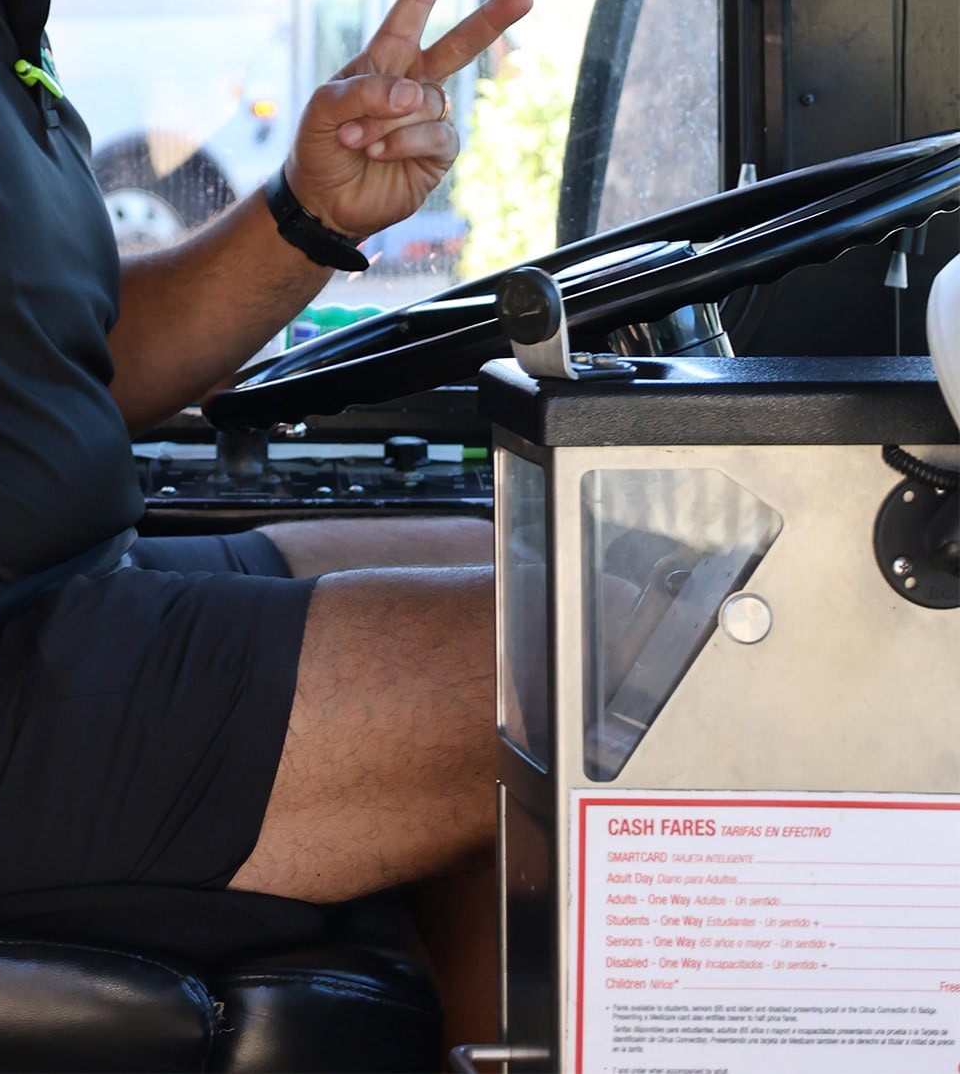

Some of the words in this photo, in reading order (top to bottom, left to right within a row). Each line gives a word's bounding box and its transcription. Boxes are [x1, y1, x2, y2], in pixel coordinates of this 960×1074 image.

[608, 819, 654, 836] CASH
[661, 819, 716, 836] FARES
[720, 826, 762, 837] TARIFAS
[765, 826, 779, 837] EN
[782, 827, 831, 838] EFECTIVO
[607, 852, 668, 864] SMARTCARD
[671, 854, 703, 863] TARJETA
[705, 854, 754, 864] INTELIGENTE
[607, 873, 632, 884] Adult
[635, 873, 654, 886] Day
[656, 874, 681, 884] Diario
[683, 876, 704, 886] para
[705, 875, 737, 885] Adultos
[607, 894, 638, 905] Adults
[648, 894, 668, 905] One
[670, 894, 691, 907] Way
[694, 895, 726, 906] Adultos
[735, 896, 747, 906] Un
[749, 895, 781, 906] sentido
[606, 915, 650, 926] Students
[660, 915, 680, 926] One
[682, 915, 703, 928] Way
[706, 916, 756, 927] Estudiantes
[764, 917, 777, 927] Un
[779, 917, 810, 927] sentido
[606, 936, 643, 947] Seniors
[653, 936, 673, 947] One
[675, 936, 696, 949] Way
[700, 937, 712, 947] 65
[714, 937, 734, 948] años
[744, 940, 772, 950] mayor
[780, 938, 792, 948] Un
[795, 938, 826, 949] sentido
[606, 957, 648, 968] Disabled
[659, 957, 679, 968] One
[681, 957, 701, 970] Way
[706, 959, 764, 970] Incapacitados
[772, 960, 785, 969] Un
[787, 960, 818, 970] sentido
[605, 978, 646, 989] Children
